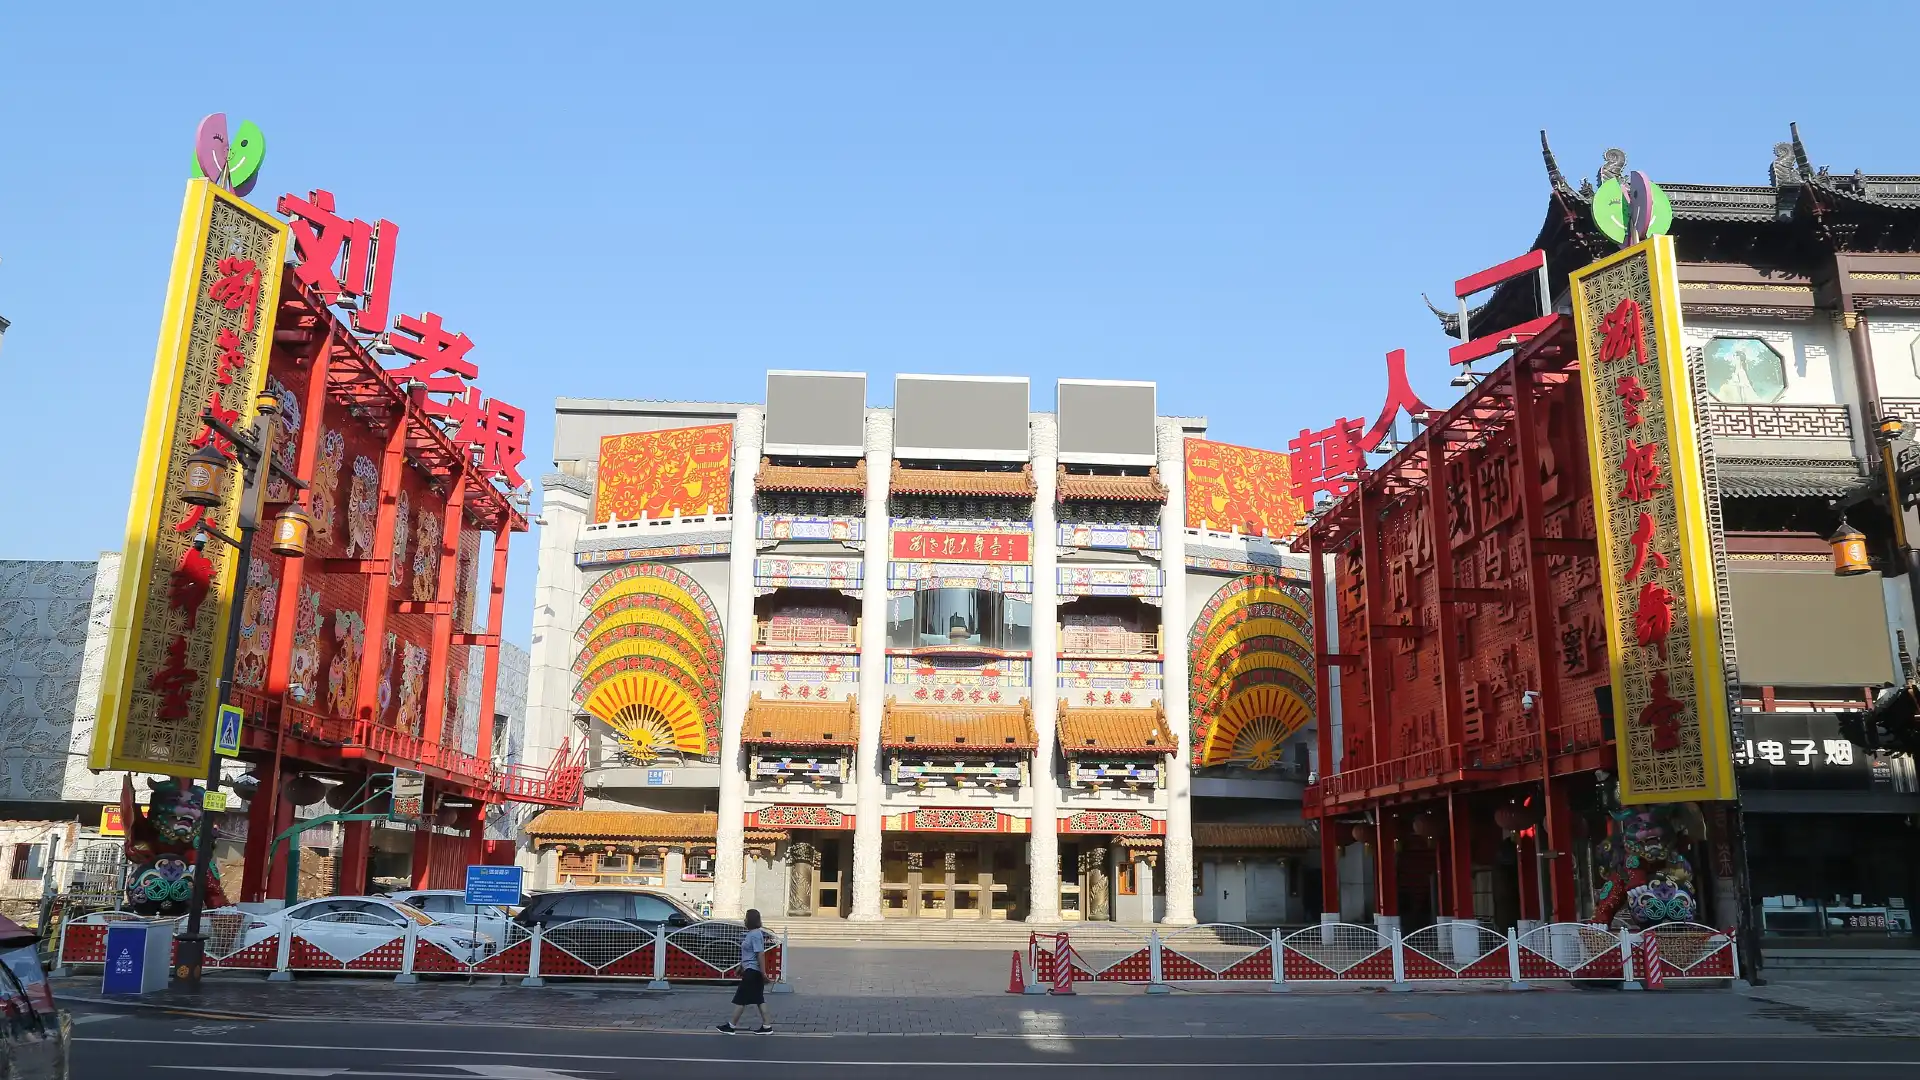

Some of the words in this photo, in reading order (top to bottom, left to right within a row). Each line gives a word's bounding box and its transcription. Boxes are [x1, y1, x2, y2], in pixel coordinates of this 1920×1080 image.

[277, 189, 526, 488] 刘老根
[694, 441, 725, 456] 吉祥
[1192, 457, 1220, 470] 如意
